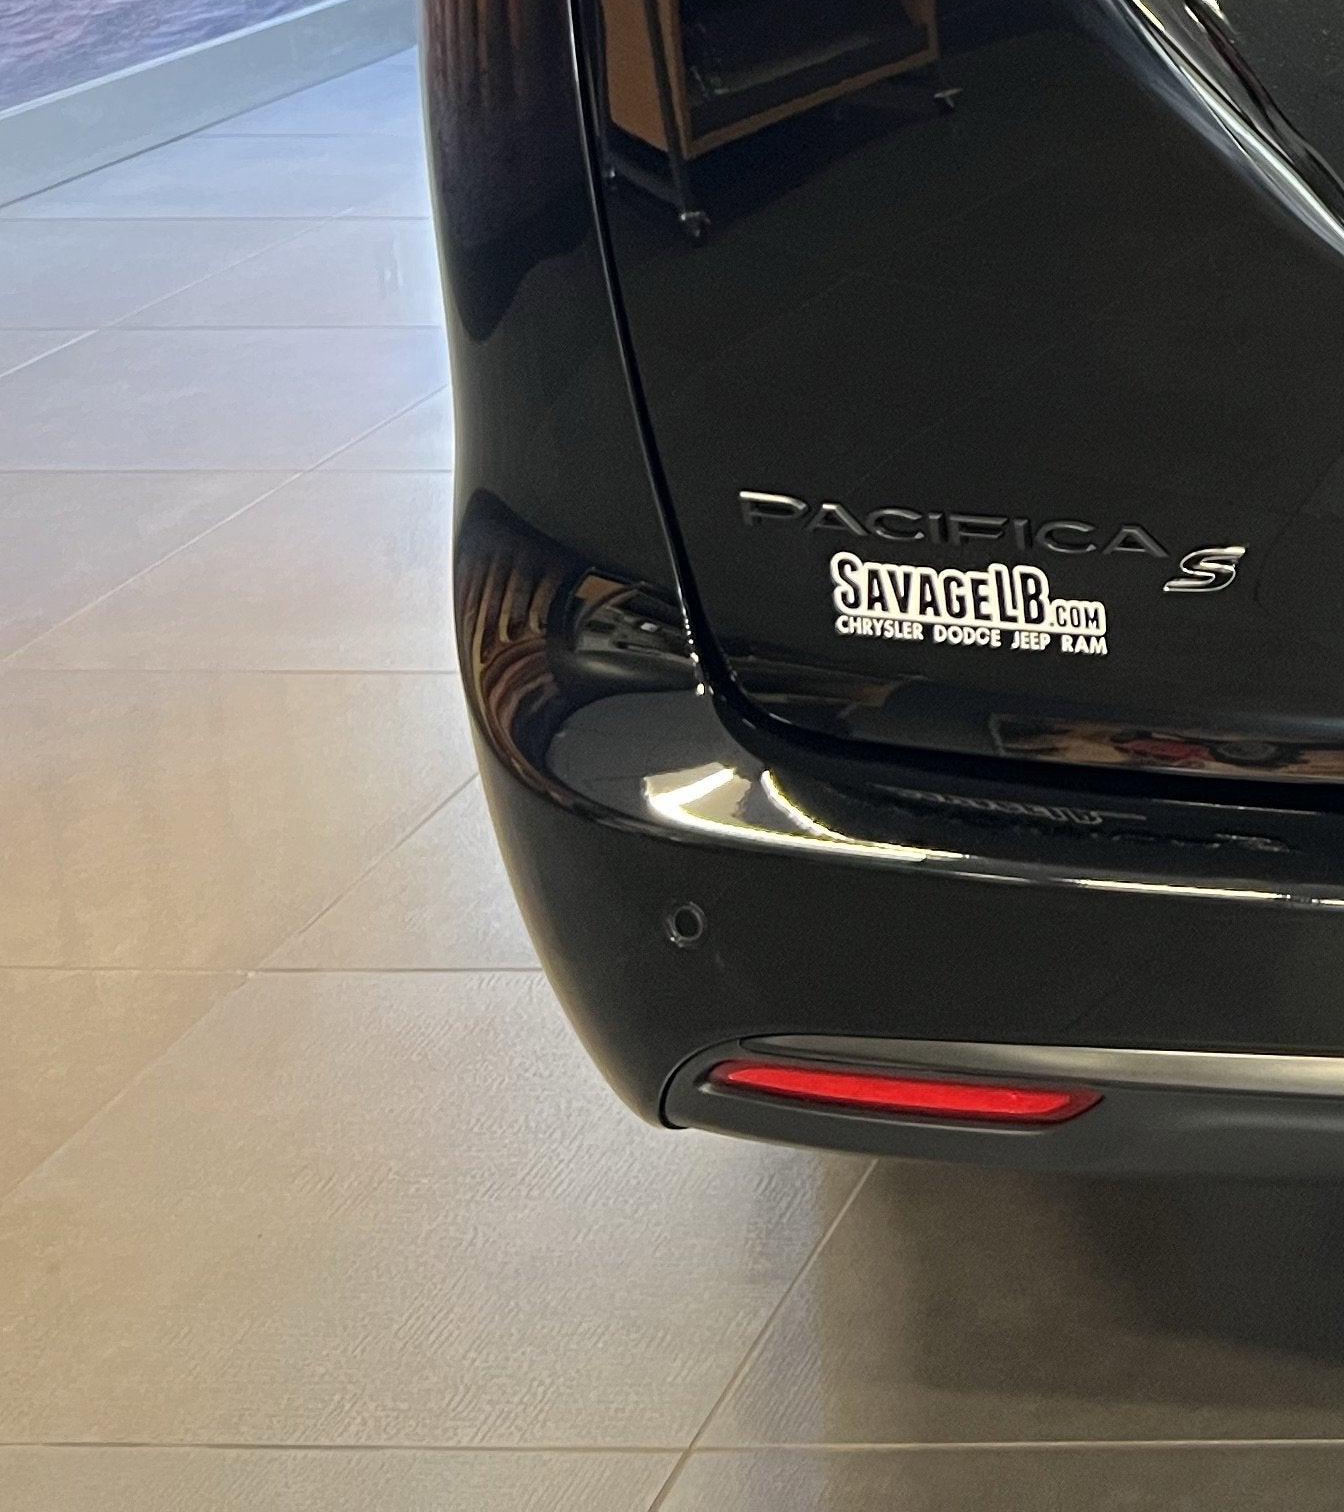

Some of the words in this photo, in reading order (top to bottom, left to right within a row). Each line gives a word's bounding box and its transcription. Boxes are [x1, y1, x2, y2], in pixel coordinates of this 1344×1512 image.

[739, 490, 1169, 559] PACIFICA
[1163, 542, 1249, 593] S
[835, 615, 924, 641] CHRYSLER
[933, 624, 1001, 647] DODGE
[1010, 631, 1050, 652] JEEP
[1060, 635, 1108, 656] RAM
